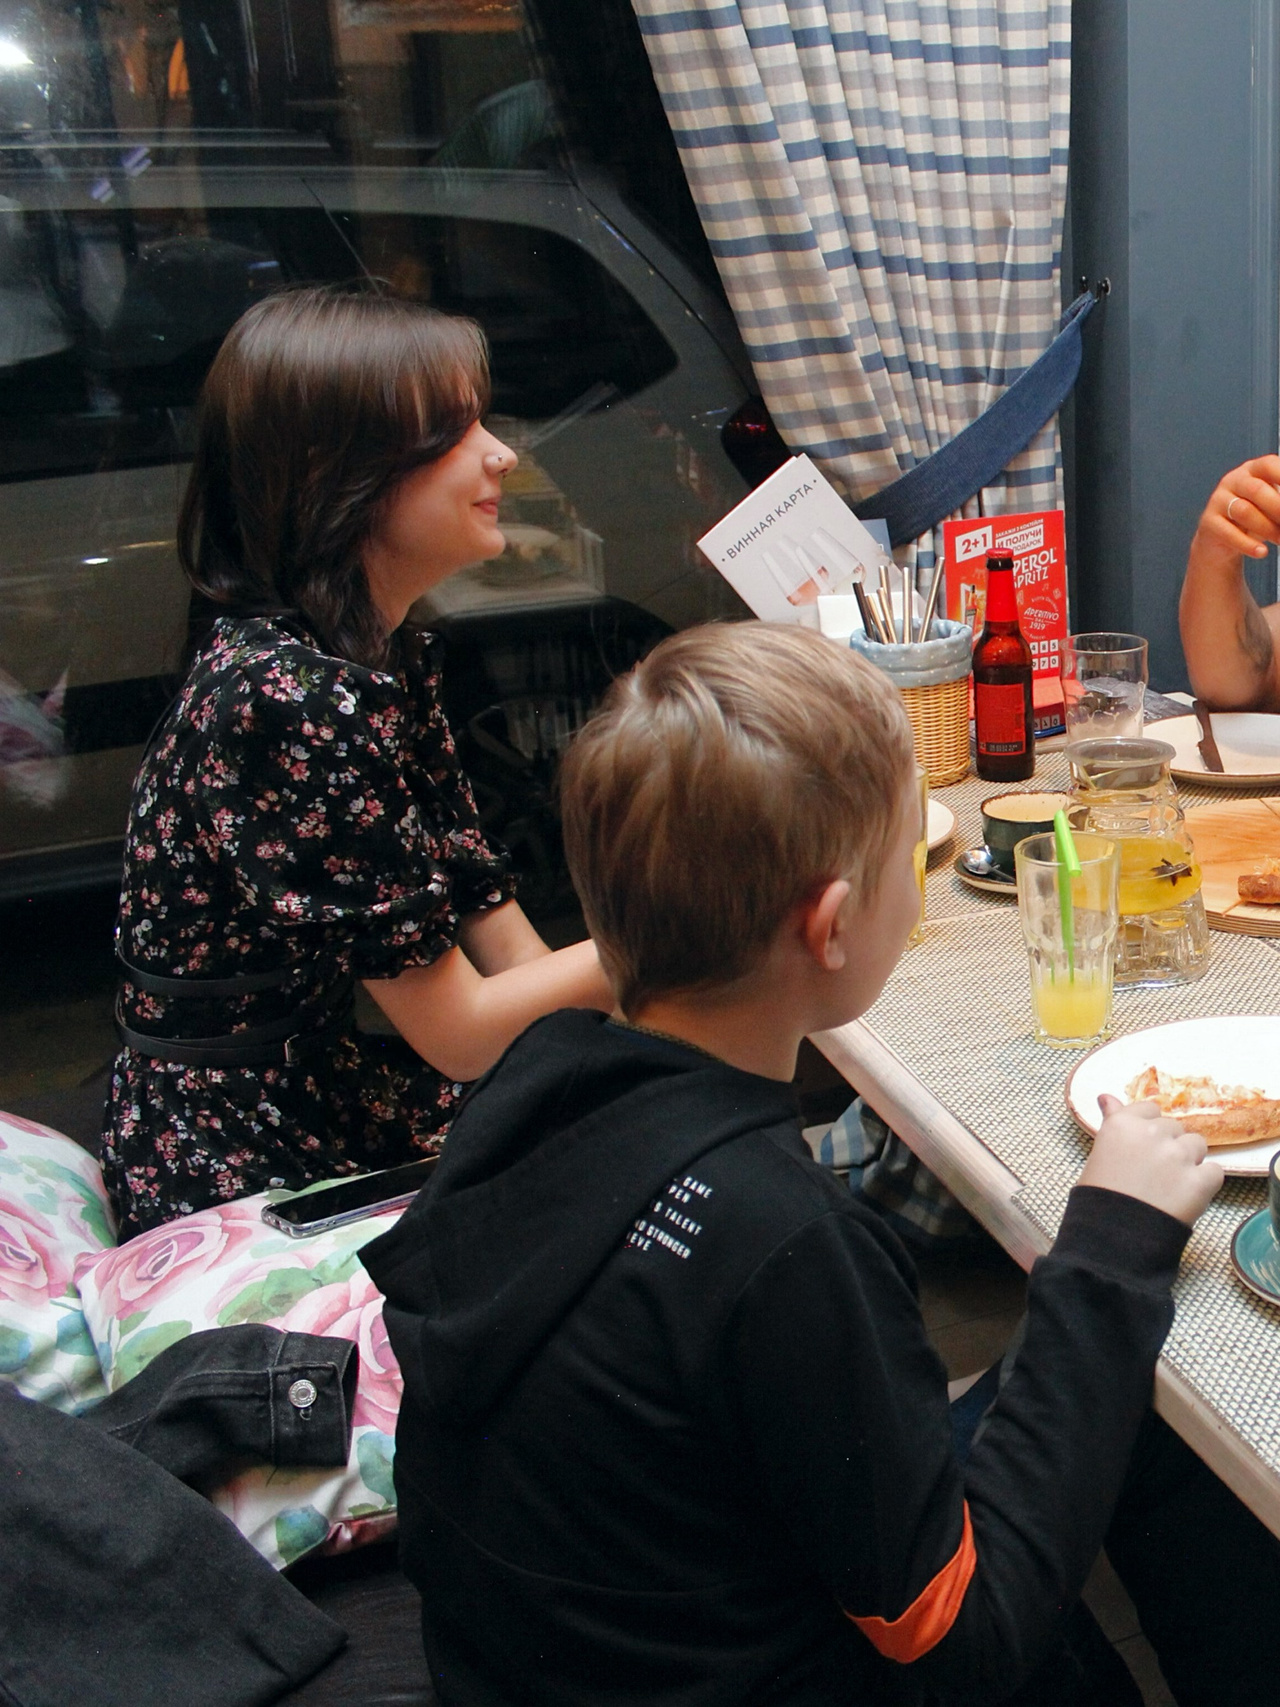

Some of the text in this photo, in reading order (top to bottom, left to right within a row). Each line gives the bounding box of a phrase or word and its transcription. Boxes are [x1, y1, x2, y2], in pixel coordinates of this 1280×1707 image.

[726, 483, 814, 559] ВИННАЯ КАРТА
[961, 533, 988, 555] 2+1
[1005, 528, 1042, 547] ПОЛУЧИ
[1013, 548, 1058, 577] PEROL
[668, 1184, 691, 1204] PEN
[682, 1176, 713, 1199] GAME
[665, 1207, 702, 1236] TALENT
[646, 1224, 692, 1259] STRONGER
